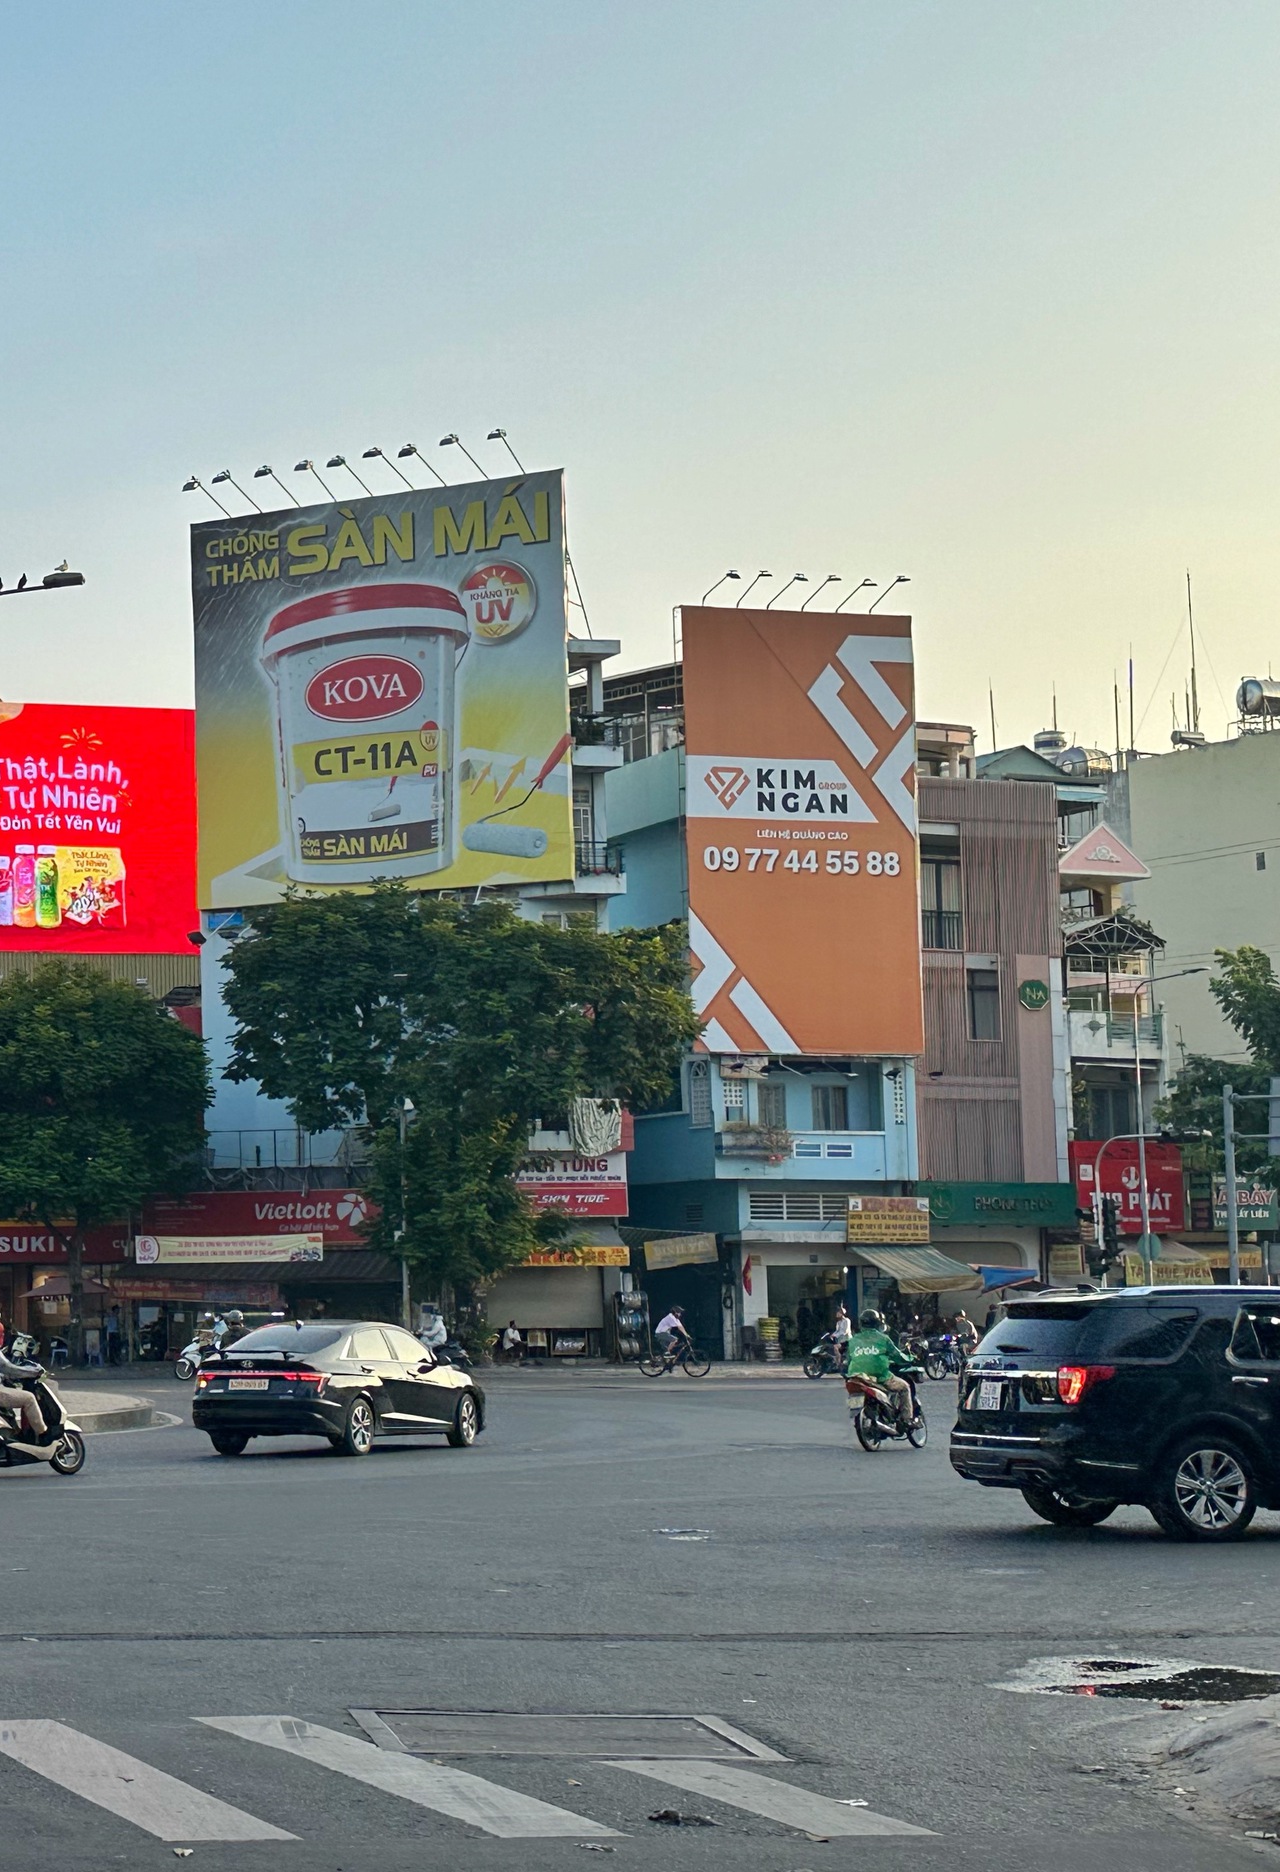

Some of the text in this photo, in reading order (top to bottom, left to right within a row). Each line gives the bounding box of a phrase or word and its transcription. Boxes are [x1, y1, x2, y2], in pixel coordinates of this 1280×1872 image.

[288, 482, 551, 577] SÀN MÁI
[206, 528, 280, 560] CHỐNG
[206, 551, 280, 587] THẤM
[505, 588, 520, 597] TIA
[475, 597, 514, 625] UV
[323, 673, 407, 706] KOVA
[314, 740, 418, 776] CT-11A
[58, 756, 130, 789] Lành,
[756, 768, 848, 790] KIM GROUP
[3, 785, 117, 813] Tự Nhiên
[756, 791, 849, 814] NGAN
[34, 811, 61, 830] Tết
[65, 814, 93, 831] Yên
[96, 817, 122, 835] Vui
[323, 833, 365, 857] SÀN
[371, 829, 408, 853] MÁI
[703, 845, 901, 877] 09 77 44 55 88
[254, 1202, 332, 1220] Vietlott
[853, 1345, 880, 1356] Grab
